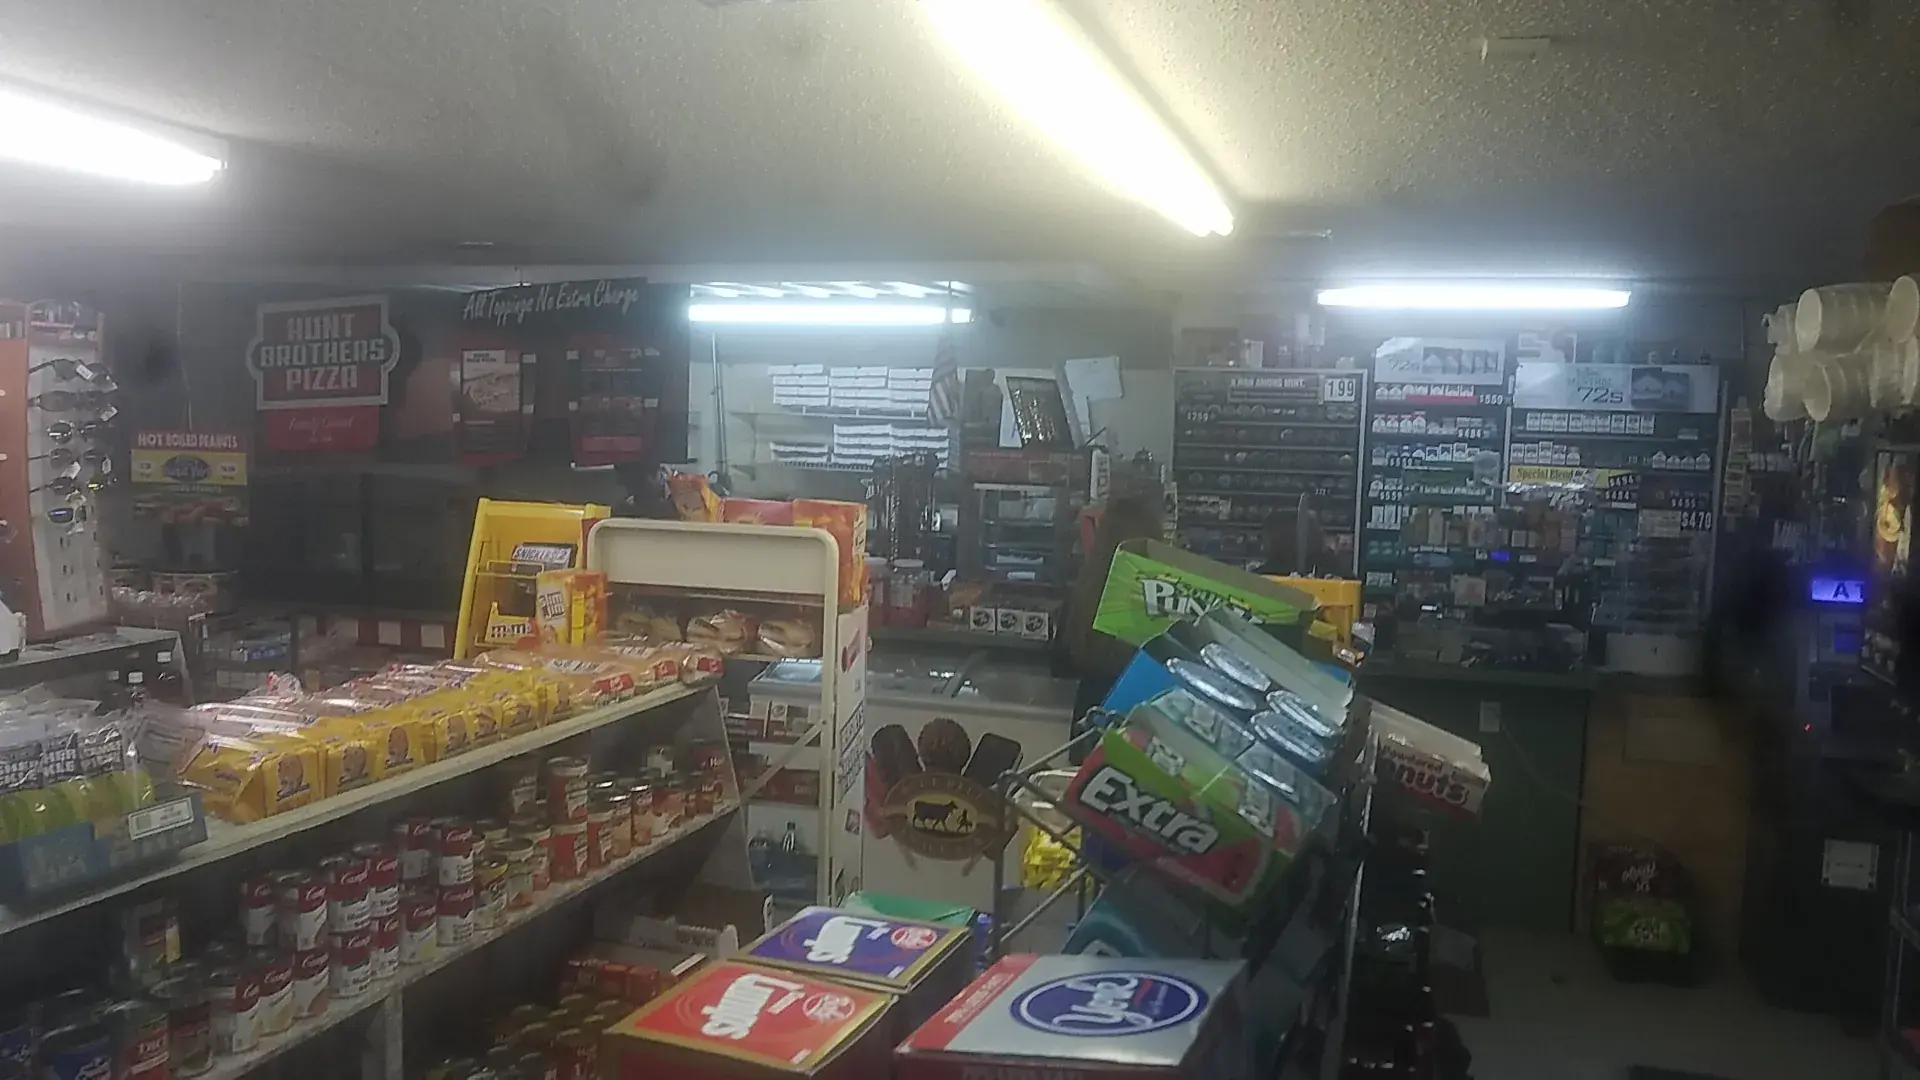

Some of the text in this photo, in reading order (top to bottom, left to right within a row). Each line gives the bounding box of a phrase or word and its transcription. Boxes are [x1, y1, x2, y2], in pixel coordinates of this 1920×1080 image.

[463, 290, 489, 321] All
[535, 284, 553, 313] No
[556, 282, 591, 310] Extra
[593, 279, 639, 316] Charge
[287, 313, 355, 341] HUNT
[260, 338, 385, 367] BROTHERS
[286, 365, 357, 391] PIZZA
[1576, 386, 1624, 405] 72s
[138, 433, 163, 447] HOT
[1080, 766, 1219, 854] Extra
